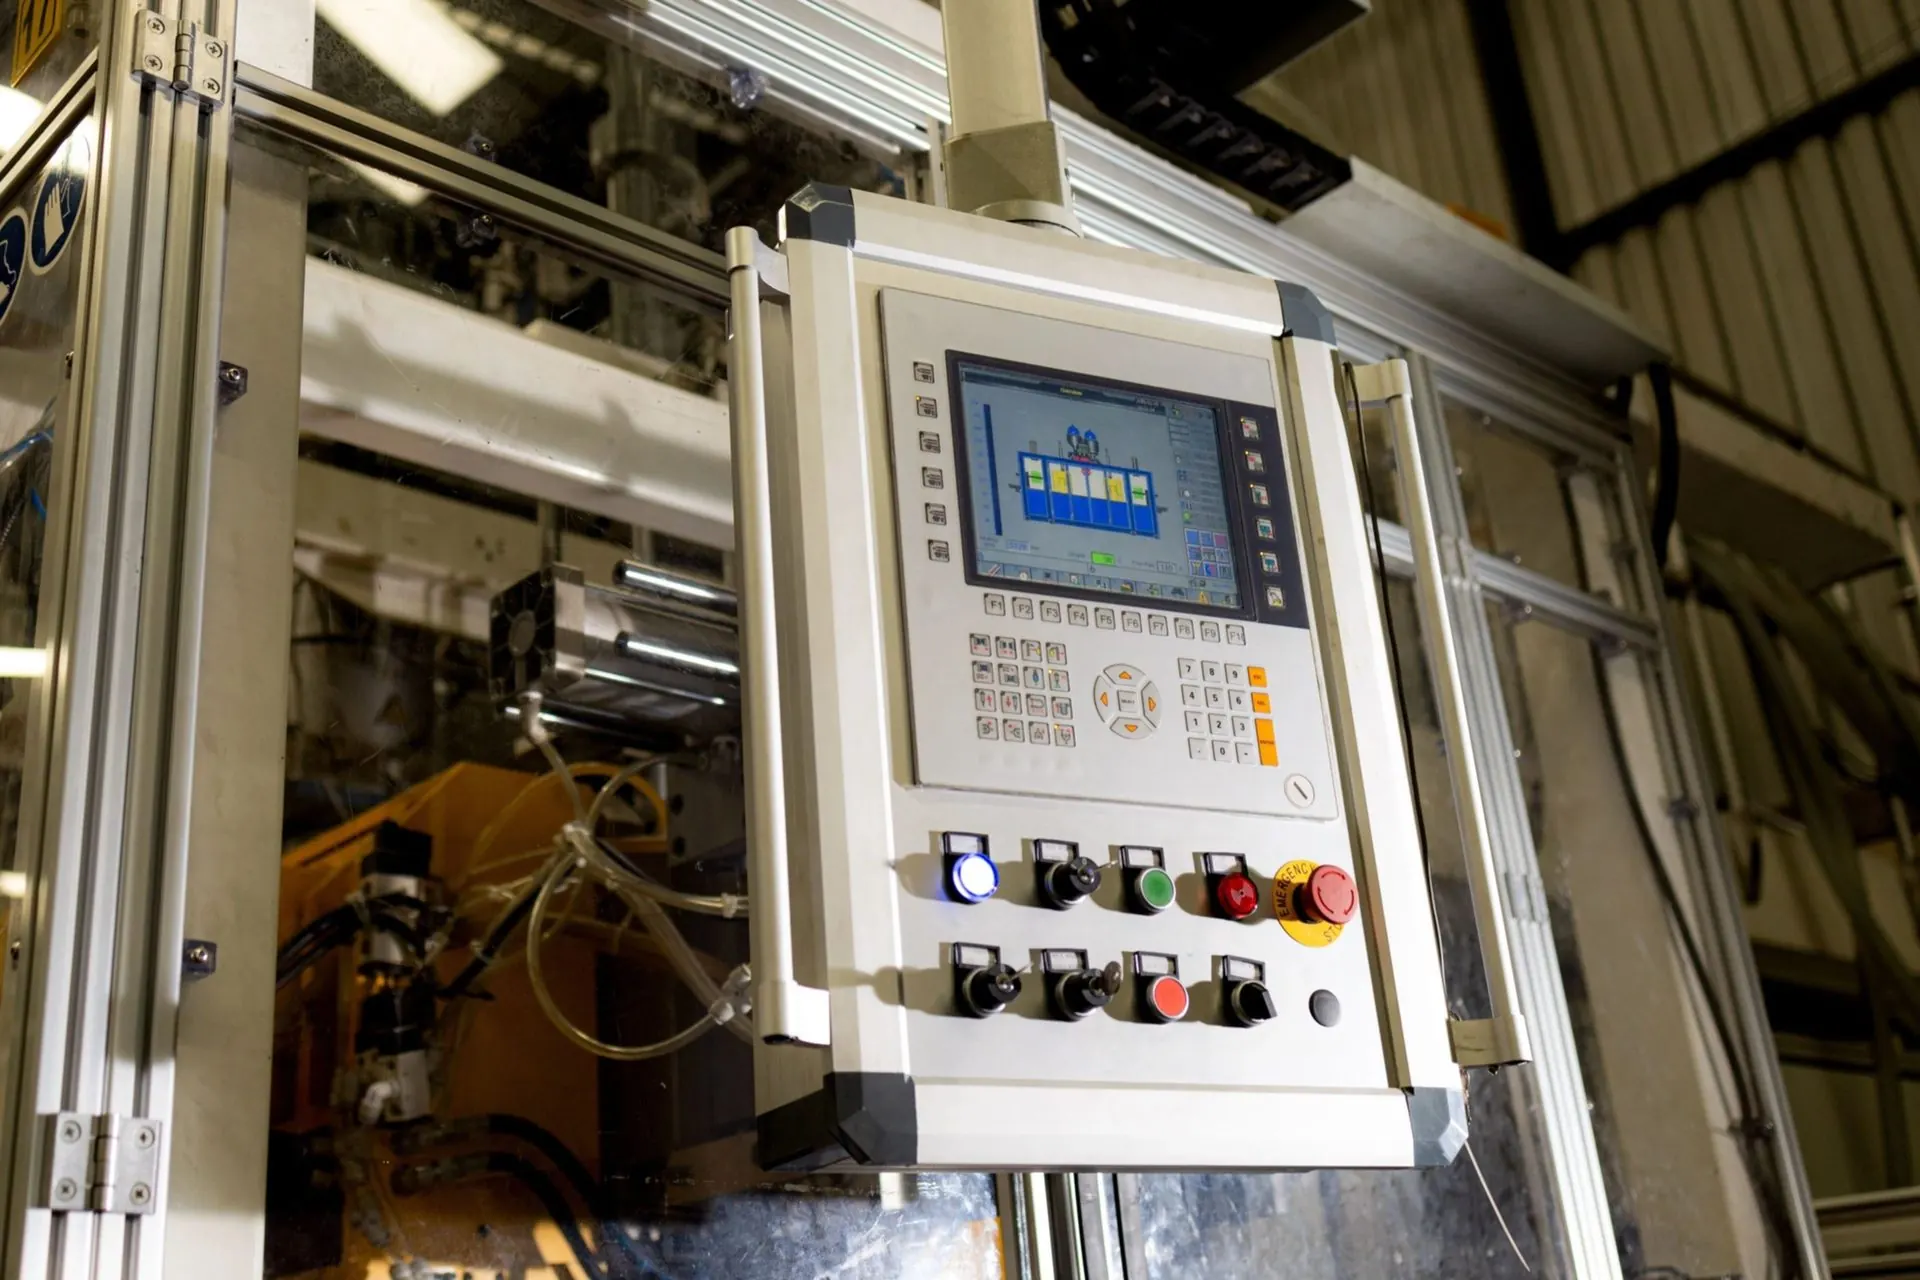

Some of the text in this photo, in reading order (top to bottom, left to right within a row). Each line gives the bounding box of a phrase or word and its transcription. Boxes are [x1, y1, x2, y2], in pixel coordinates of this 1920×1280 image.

[990, 600, 1003, 610] F1
[1018, 604, 1031, 614] F2
[1046, 607, 1059, 618] F3
[1073, 611, 1086, 621] F4
[1100, 614, 1113, 625] F5
[1126, 618, 1139, 628] F6
[1152, 621, 1165, 631] F7
[1178, 624, 1191, 634] F8
[1204, 627, 1216, 638] F9
[1186, 664, 1191, 672] 7
[1209, 667, 1215, 676] 8
[1232, 670, 1238, 679] 9
[1189, 691, 1195, 700] 4
[1212, 694, 1218, 702] 5
[1236, 696, 1241, 705] 6
[1193, 718, 1245, 731] 1 2 3
[1220, 747, 1225, 755] 0
